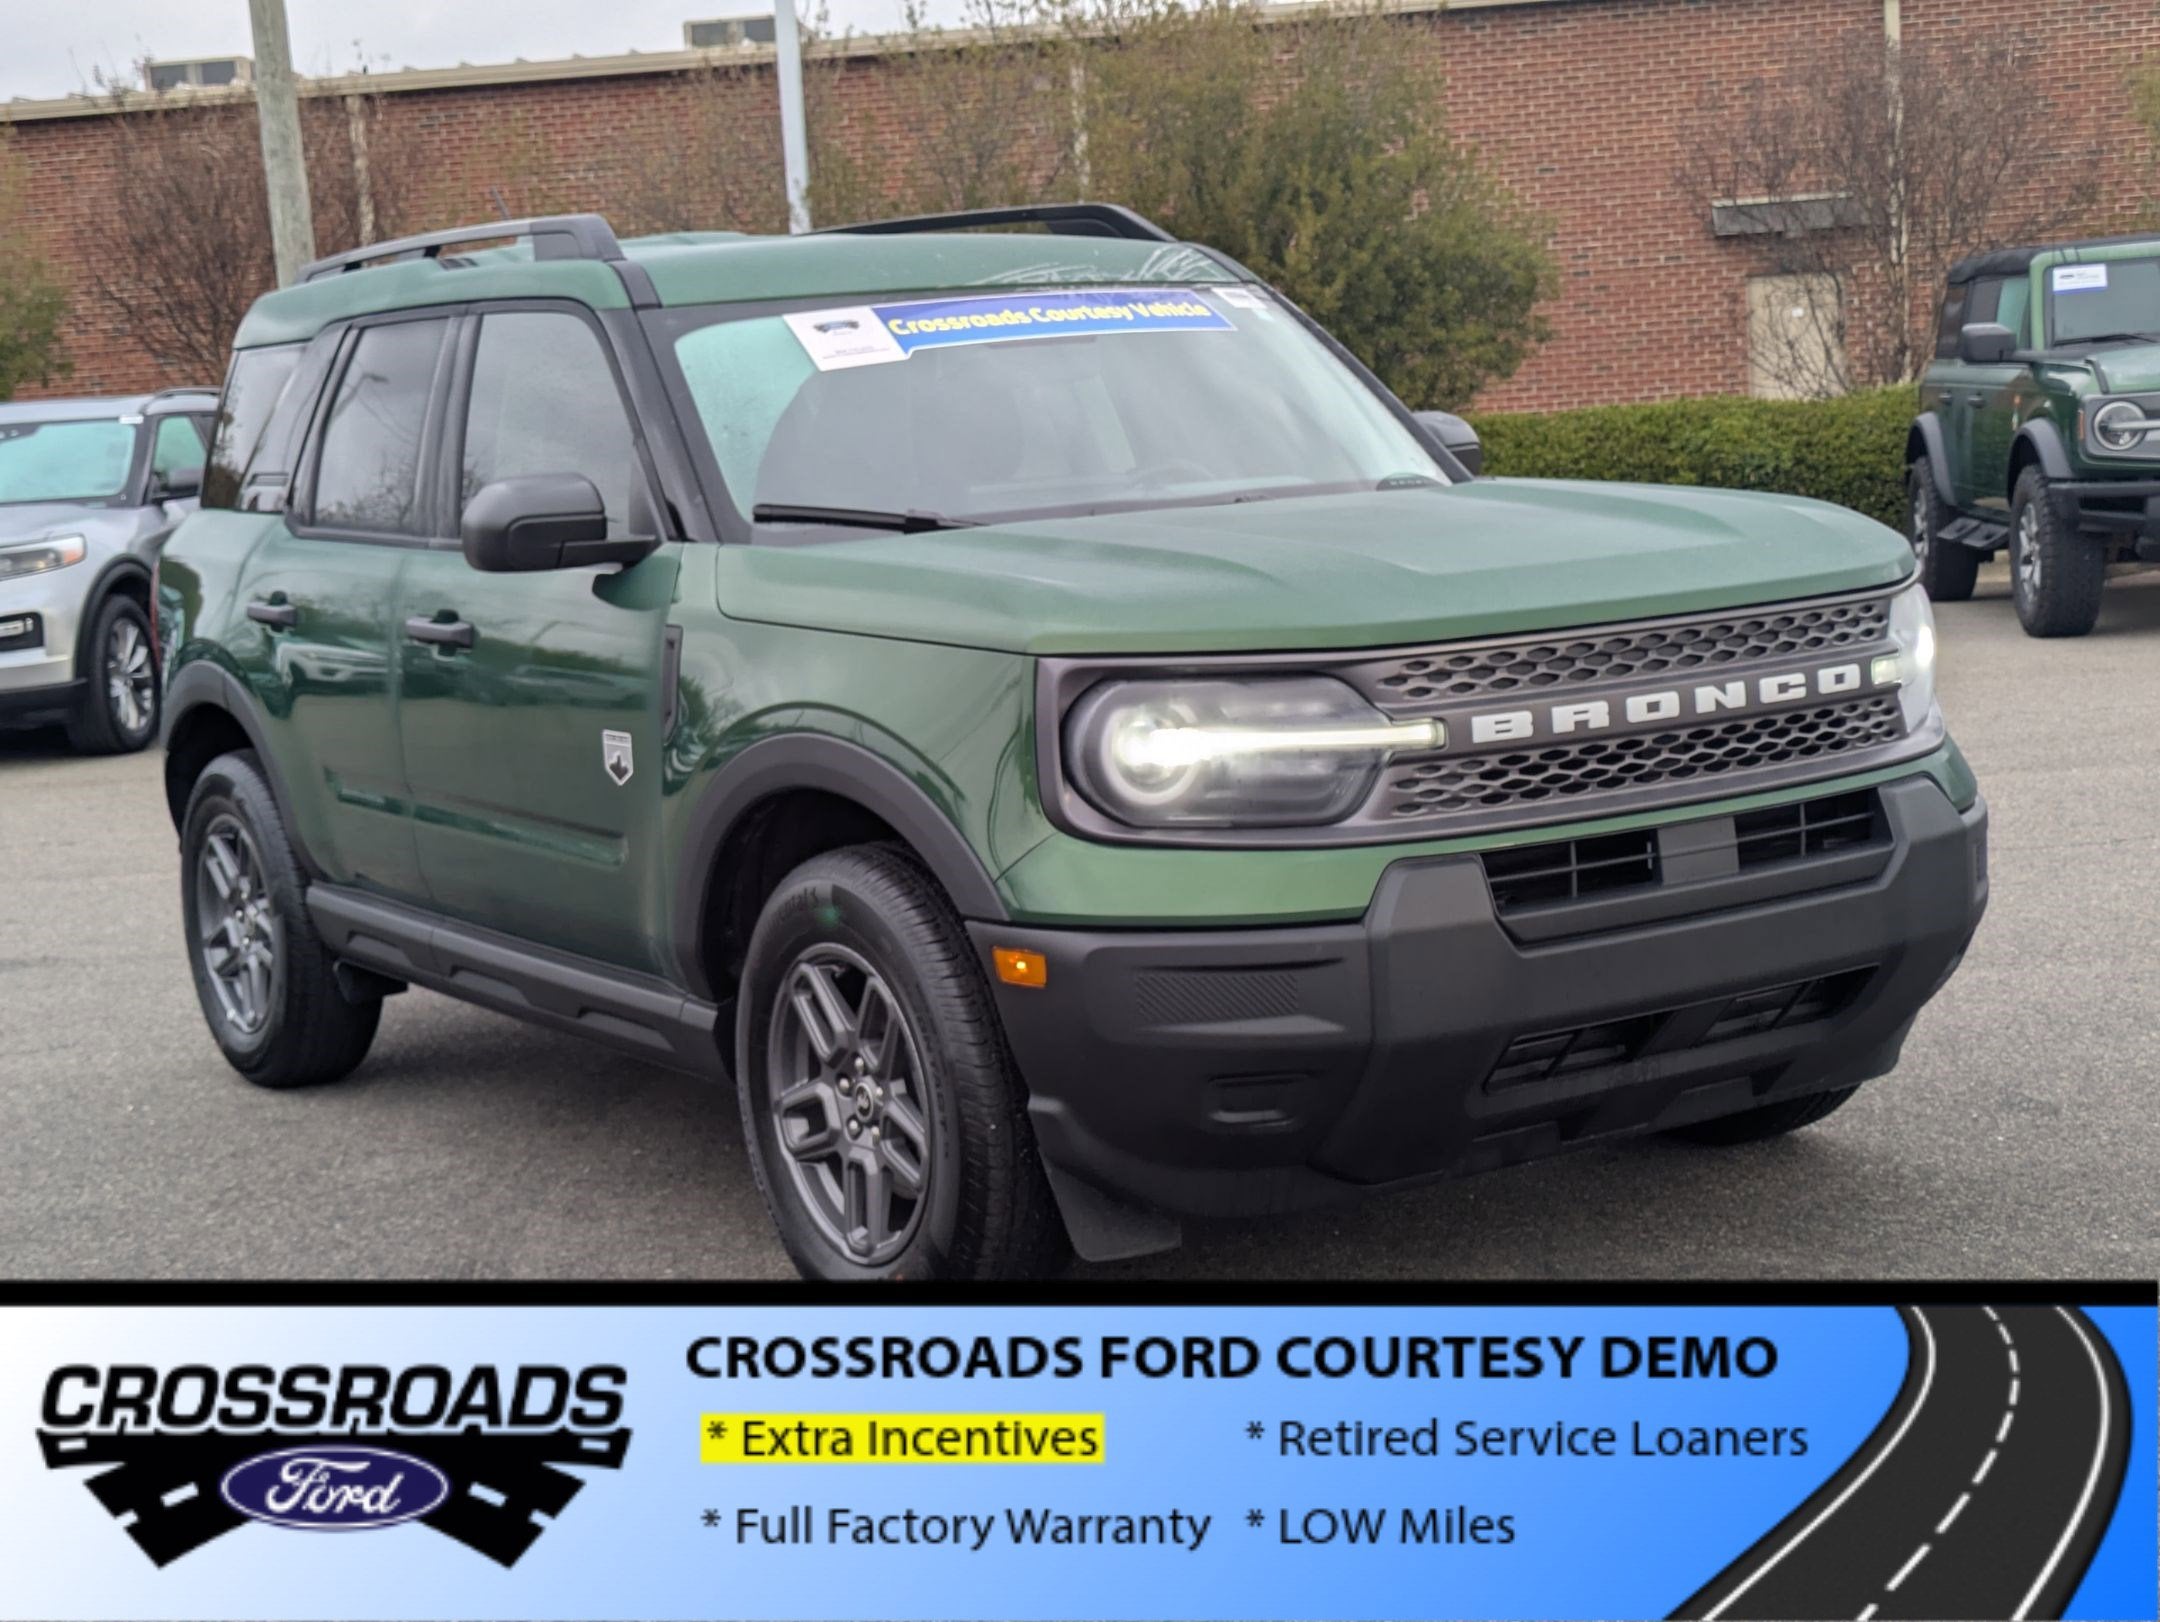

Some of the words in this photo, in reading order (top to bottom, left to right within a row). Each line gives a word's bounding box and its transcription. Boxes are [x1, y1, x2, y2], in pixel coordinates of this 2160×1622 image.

[887, 308, 1033, 336] Crossroads
[1031, 303, 1133, 323] Courtesy
[1129, 301, 1212, 319] Vehicle
[1471, 663, 1861, 744] BRONCO
